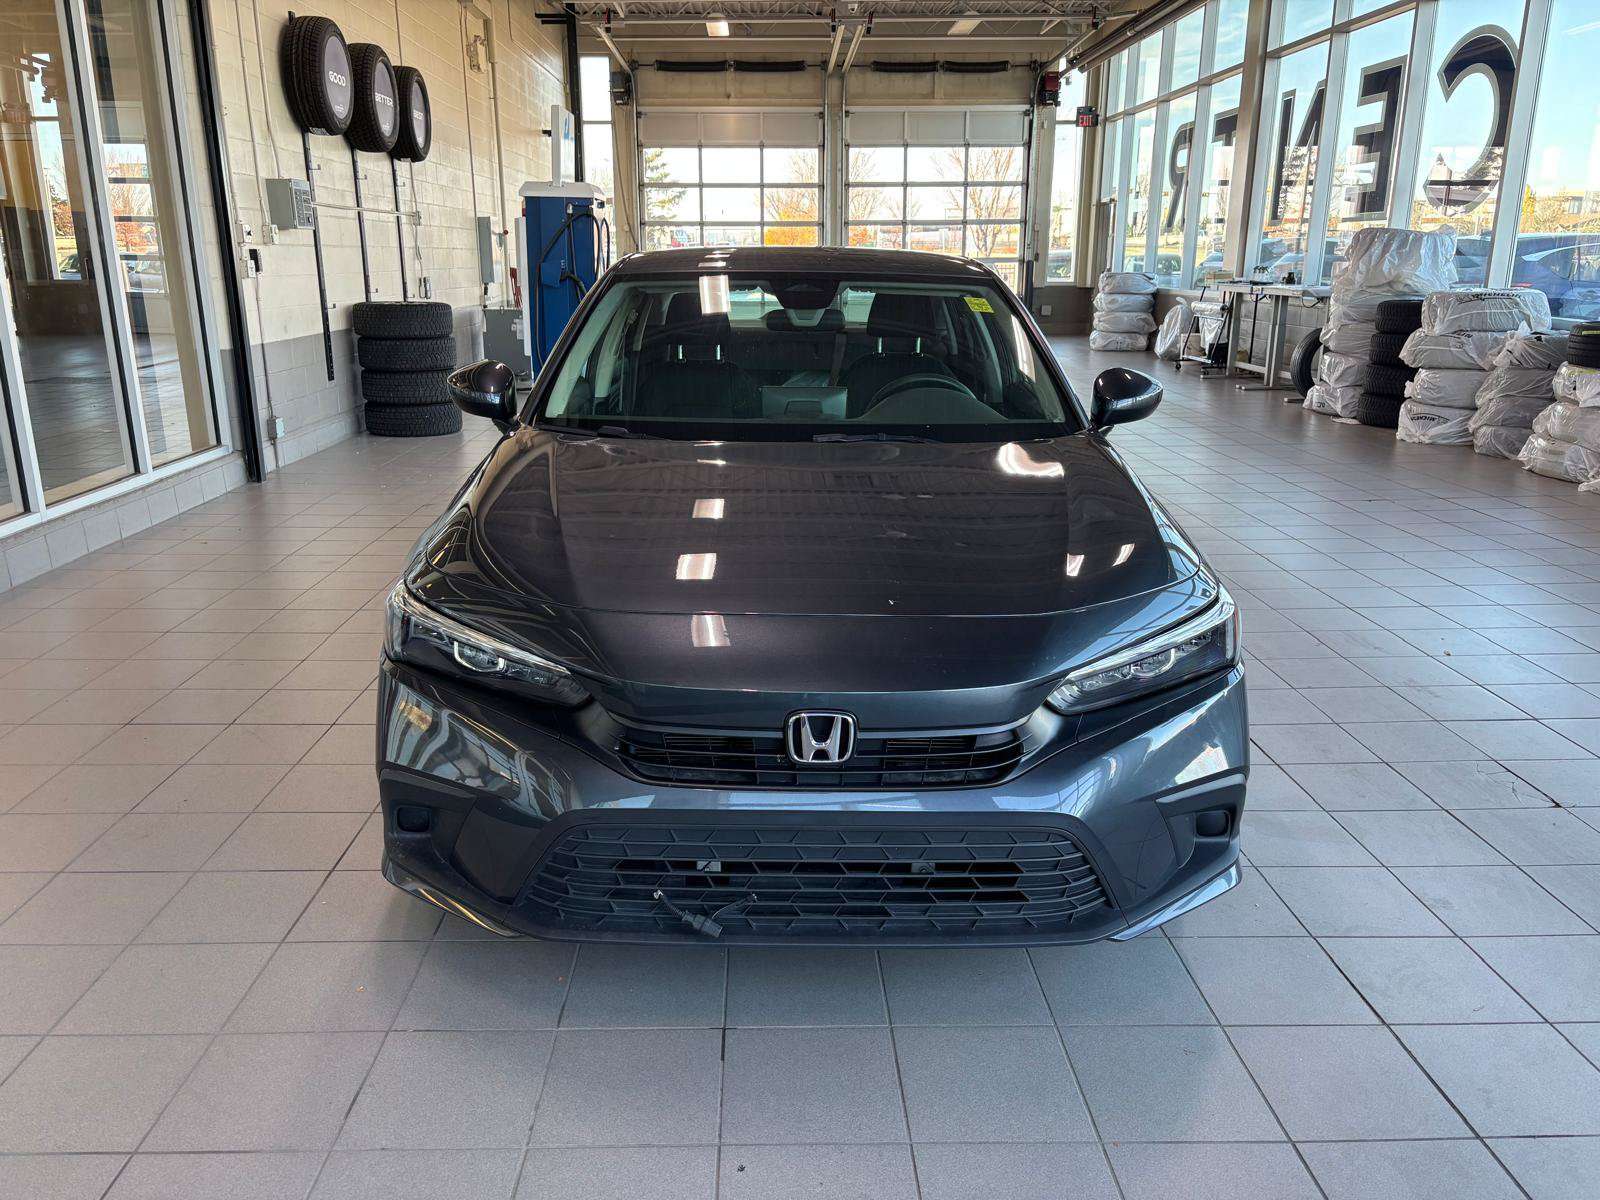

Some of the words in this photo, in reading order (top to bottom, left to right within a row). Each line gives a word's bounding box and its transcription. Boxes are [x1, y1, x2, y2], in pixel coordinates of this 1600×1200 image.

[328, 70, 346, 87] GOOD
[374, 91, 394, 107] BETTER
[412, 109, 424, 120] BEST
[1079, 114, 1092, 126] EXIT
